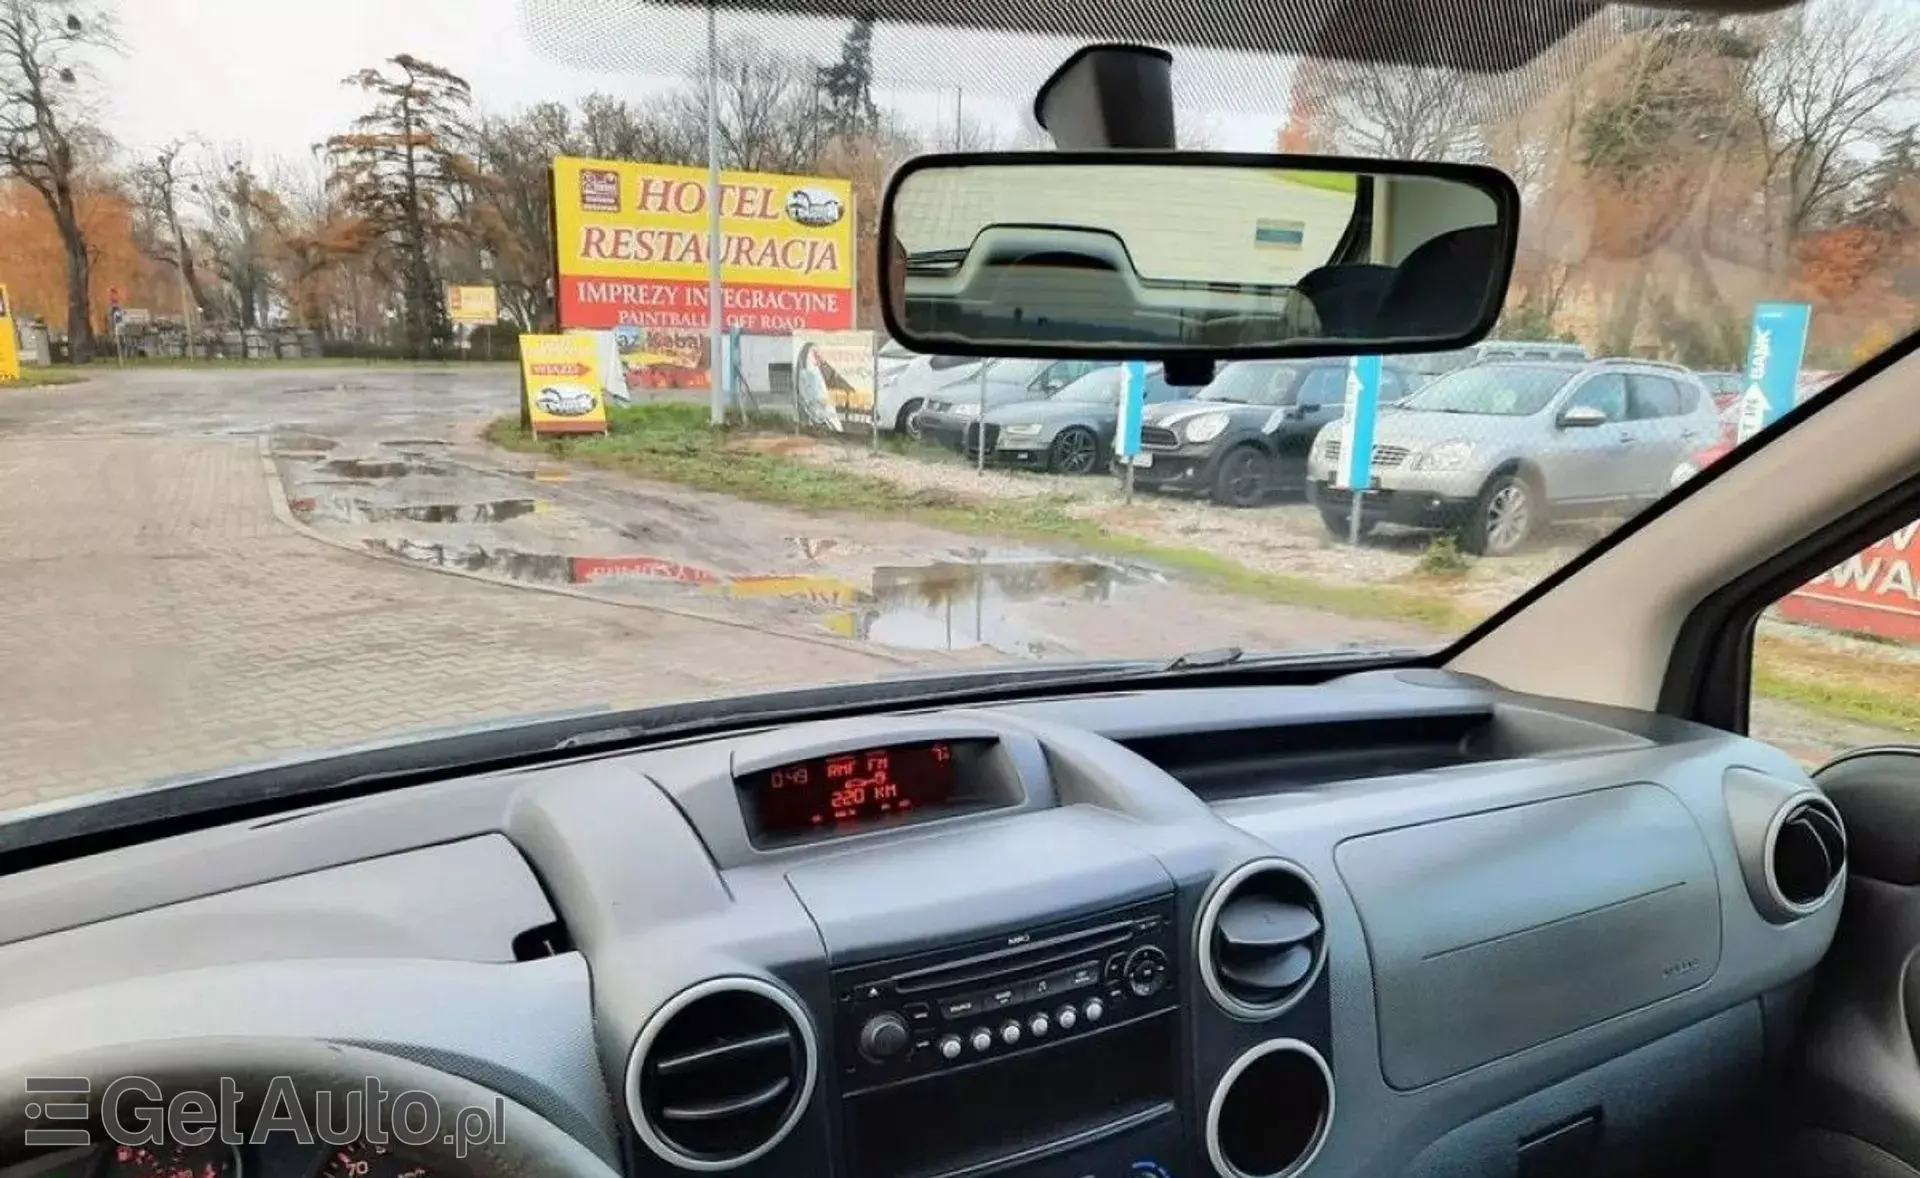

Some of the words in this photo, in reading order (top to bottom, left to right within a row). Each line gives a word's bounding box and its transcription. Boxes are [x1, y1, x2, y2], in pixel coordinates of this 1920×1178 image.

[637, 177, 779, 220] HOTEL
[580, 226, 838, 275] RESTAURACJA
[576, 282, 678, 306] IMPREZY
[685, 287, 839, 314] INEGRACYJNE
[618, 310, 708, 327] PAINTBALL
[726, 314, 757, 328] OFF
[762, 316, 806, 330] ROAD
[831, 788, 865, 808] 220
[874, 784, 897, 800] KM
